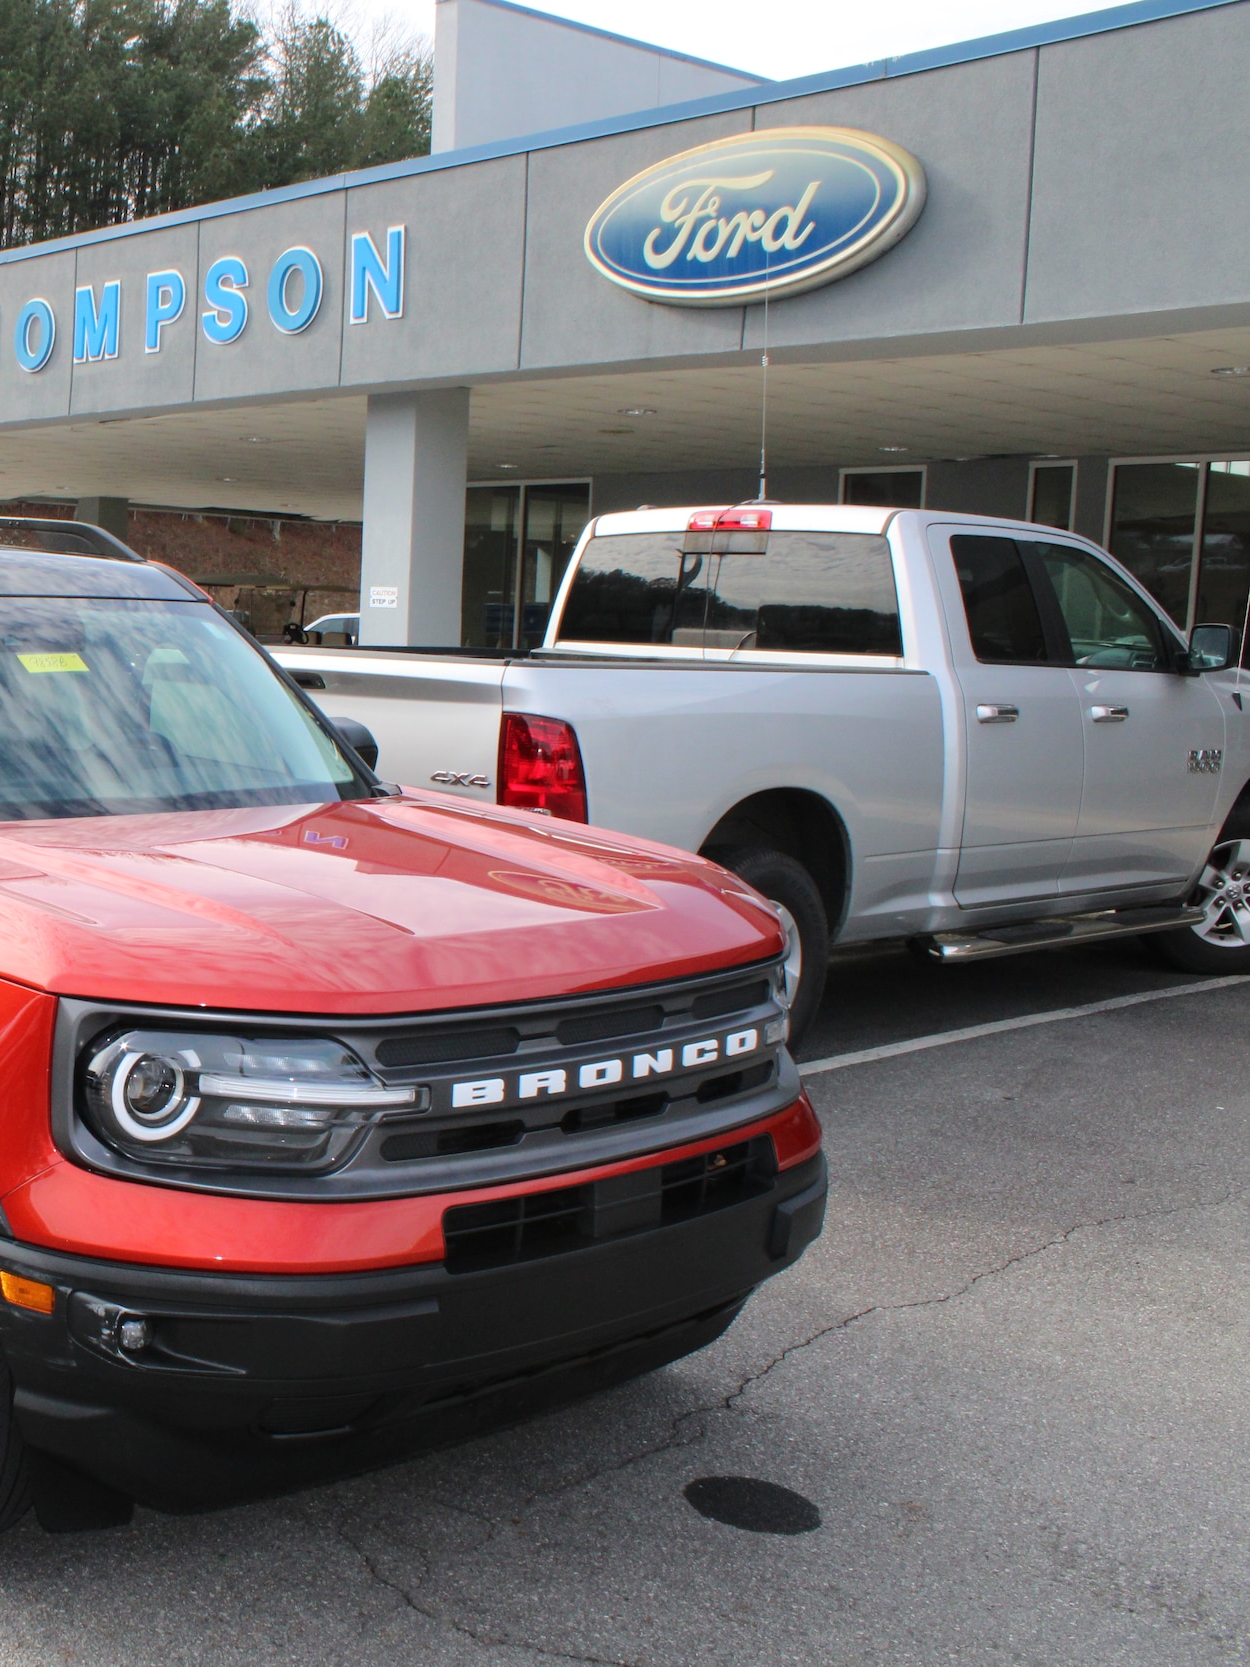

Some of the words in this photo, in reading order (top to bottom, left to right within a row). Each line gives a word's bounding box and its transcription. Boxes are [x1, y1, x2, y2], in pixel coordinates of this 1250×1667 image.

[643, 168, 821, 270] Ford
[1188, 749, 1222, 761] RAM
[451, 1028, 758, 1108] BRONCO
